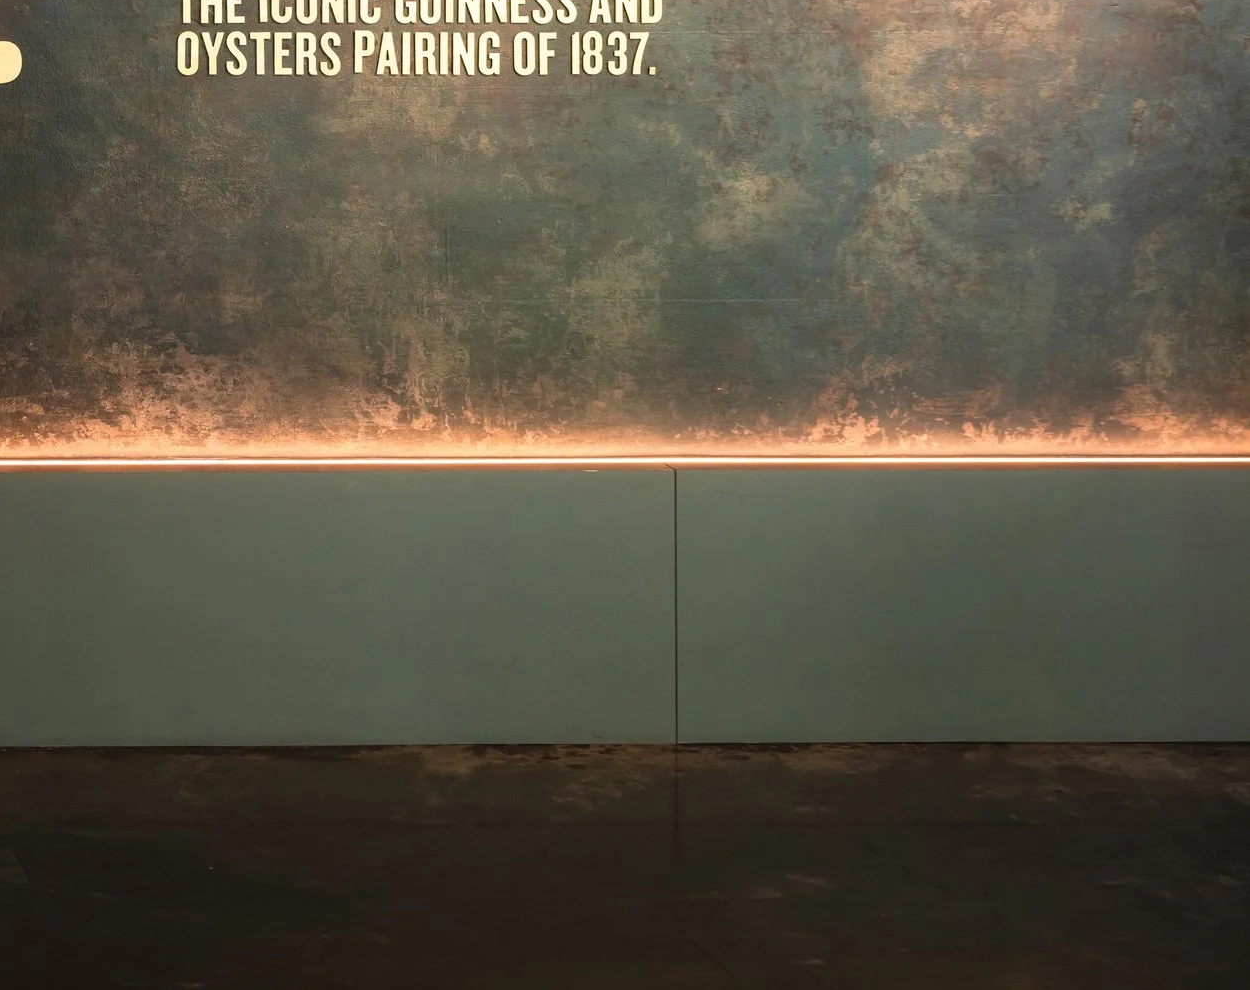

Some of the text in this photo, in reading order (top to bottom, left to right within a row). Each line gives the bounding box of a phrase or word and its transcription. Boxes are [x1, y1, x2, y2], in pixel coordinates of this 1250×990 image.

[176, 30, 657, 76] OYSTERS PAIRING OF 1837.
